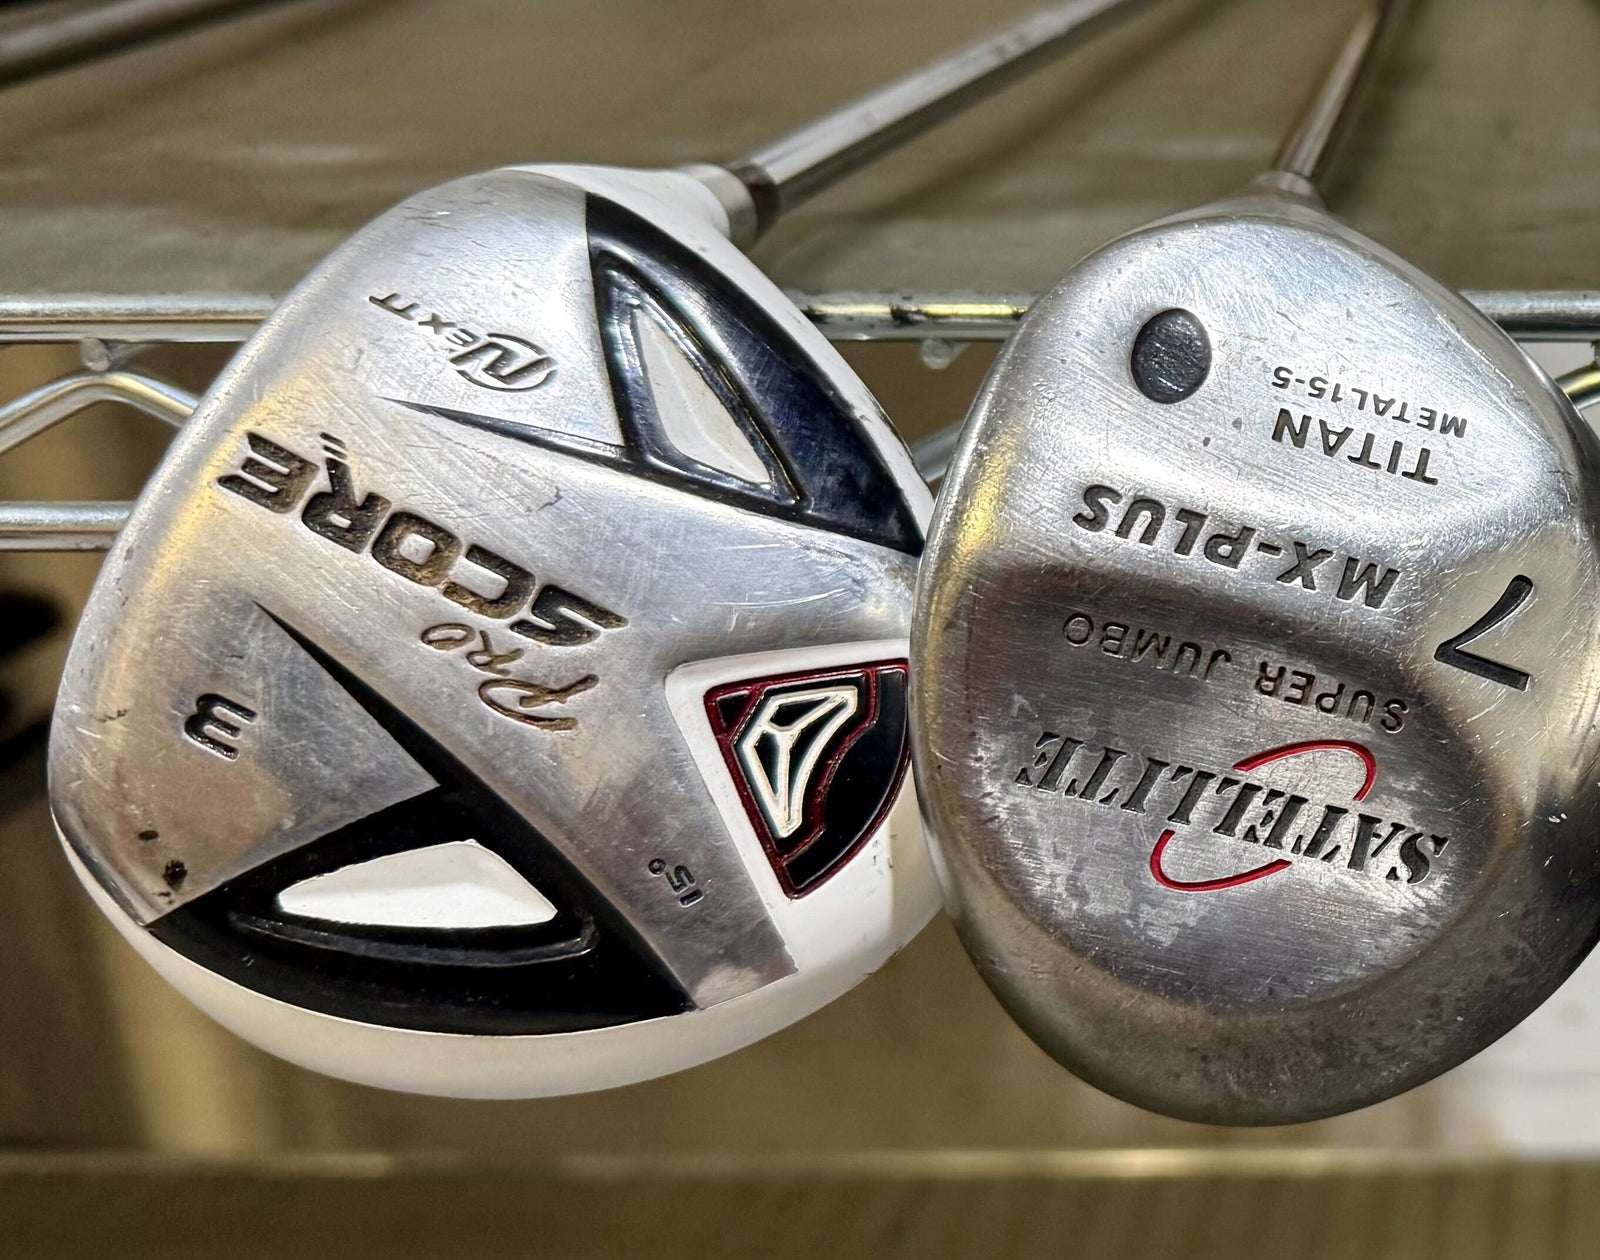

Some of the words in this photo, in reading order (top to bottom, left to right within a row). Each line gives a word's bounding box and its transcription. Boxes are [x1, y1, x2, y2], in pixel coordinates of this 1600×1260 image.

[1271, 407, 1439, 486] TITAN
[216, 431, 630, 647] SCORE
[1072, 483, 1401, 610] MX-PLUS
[1062, 611, 1233, 682] JUMBO
[1433, 573, 1536, 693] 7
[184, 692, 259, 762] 3
[1254, 660, 1412, 735] SUPER
[1013, 730, 1451, 886] SATELLITE
[647, 857, 705, 908] 15°
